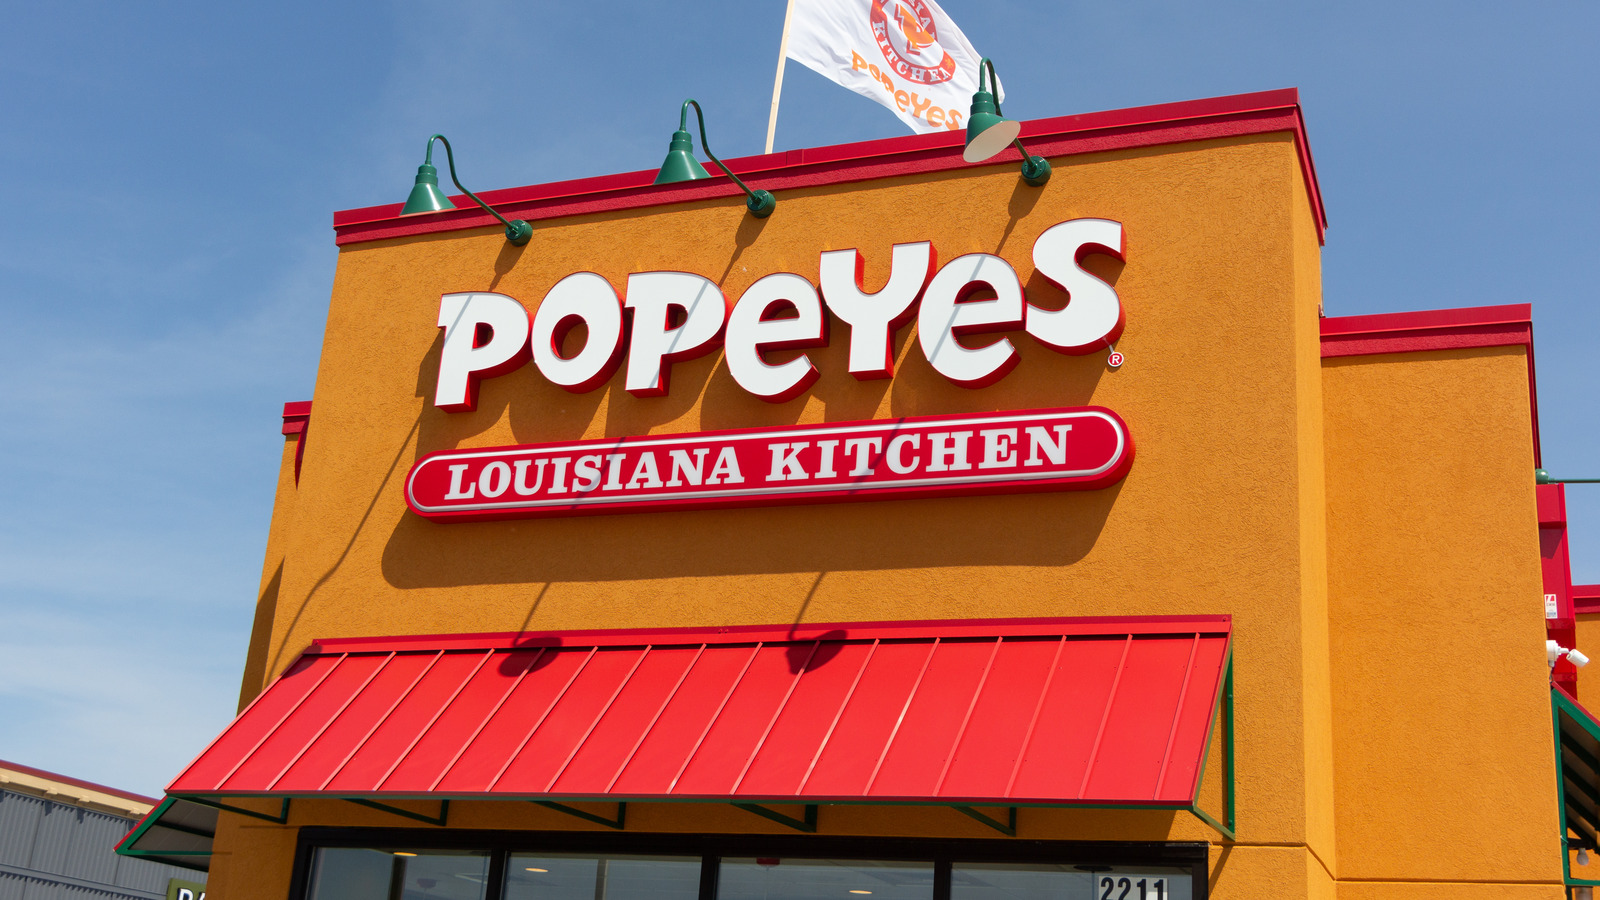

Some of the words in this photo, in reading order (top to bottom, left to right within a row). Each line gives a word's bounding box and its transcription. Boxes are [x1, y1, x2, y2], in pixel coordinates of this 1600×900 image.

[444, 446, 745, 500] LOUISIANA
[765, 424, 1072, 482] KITCHEN
[1100, 876, 1164, 900] 2211
